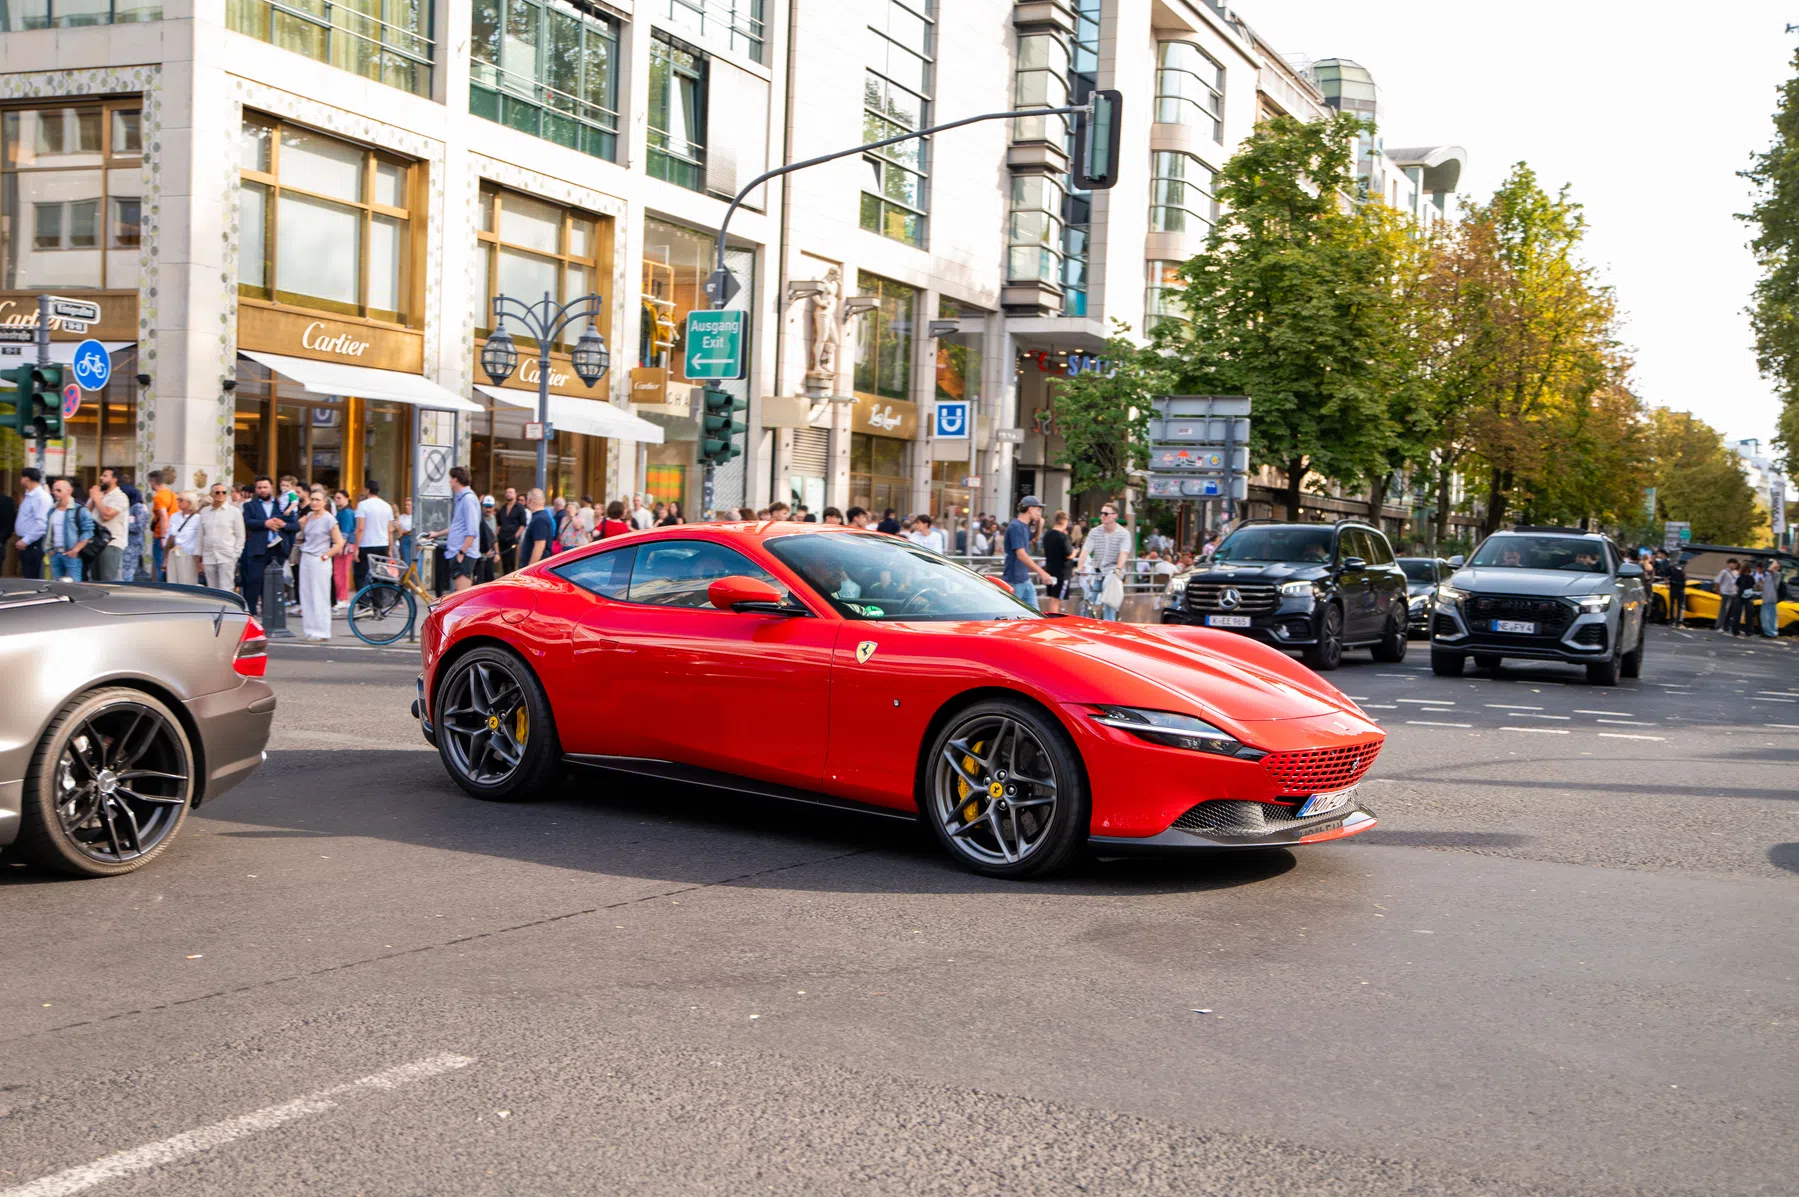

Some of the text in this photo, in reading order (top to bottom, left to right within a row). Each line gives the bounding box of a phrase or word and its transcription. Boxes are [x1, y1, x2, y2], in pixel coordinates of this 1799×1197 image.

[691, 320, 739, 334] Ausgang
[302, 321, 369, 356] Cartier
[702, 336, 724, 348] Exit
[634, 381, 661, 390] Cartier
